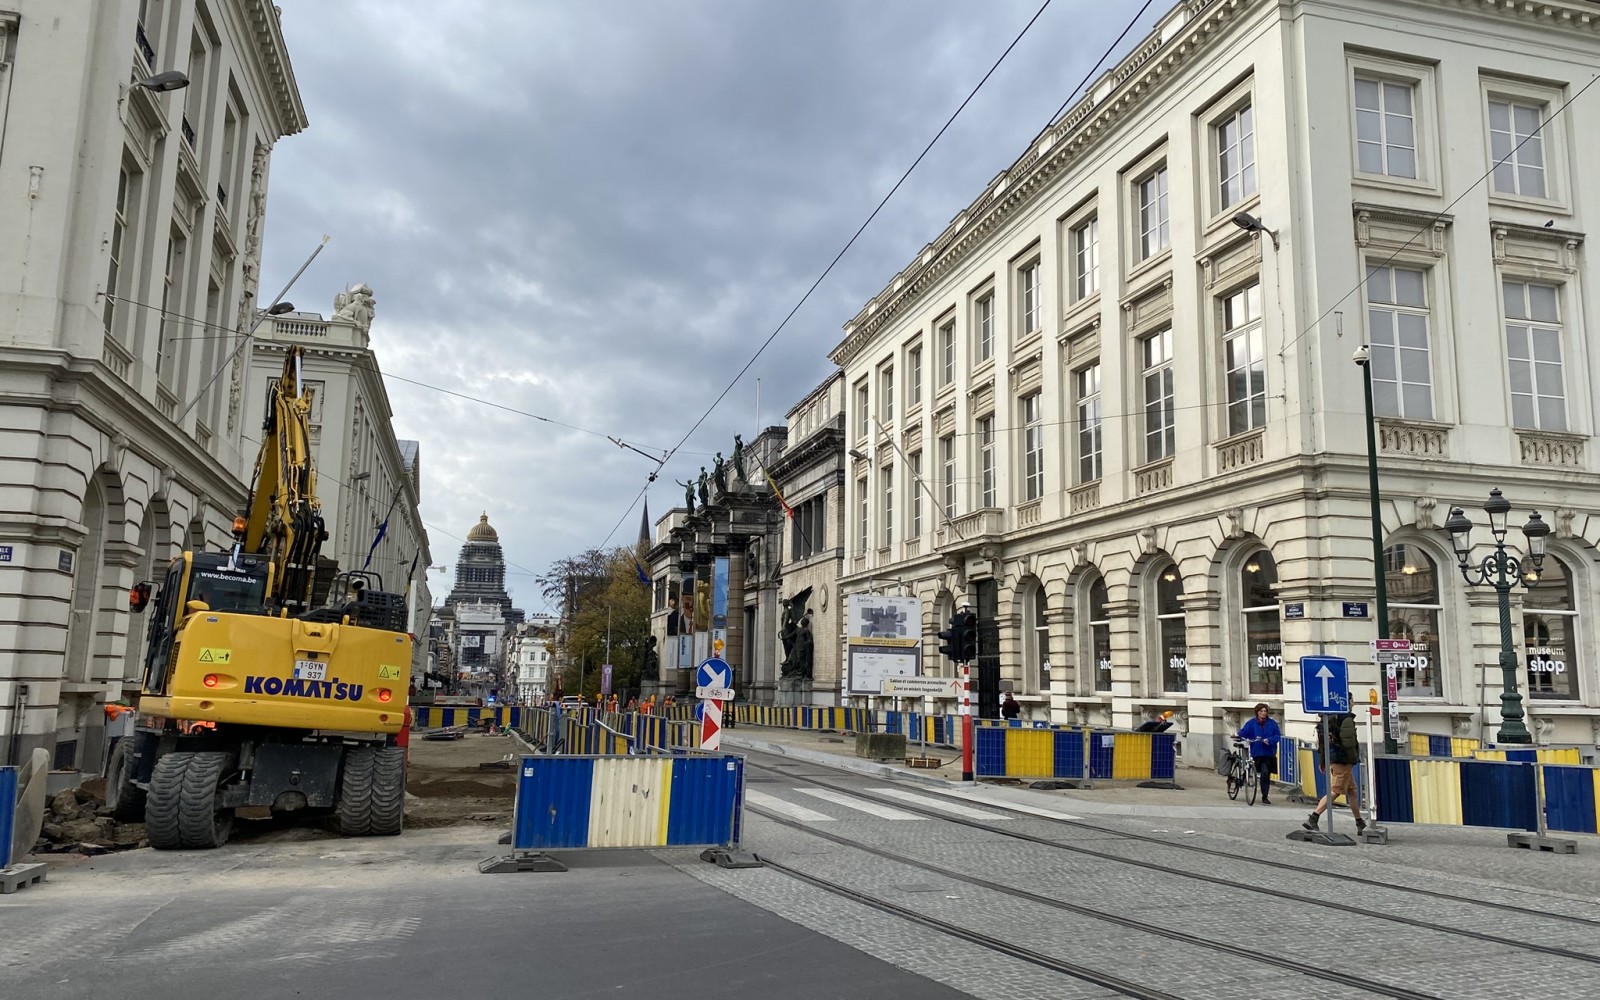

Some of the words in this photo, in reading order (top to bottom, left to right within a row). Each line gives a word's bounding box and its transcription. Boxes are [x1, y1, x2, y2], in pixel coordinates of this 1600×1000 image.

[1529, 647, 1564, 655] museum
[1257, 652, 1282, 670] shop
[1530, 656, 1565, 675] shop
[307, 671, 322, 679] 937
[244, 676, 363, 702] KOMATSU
